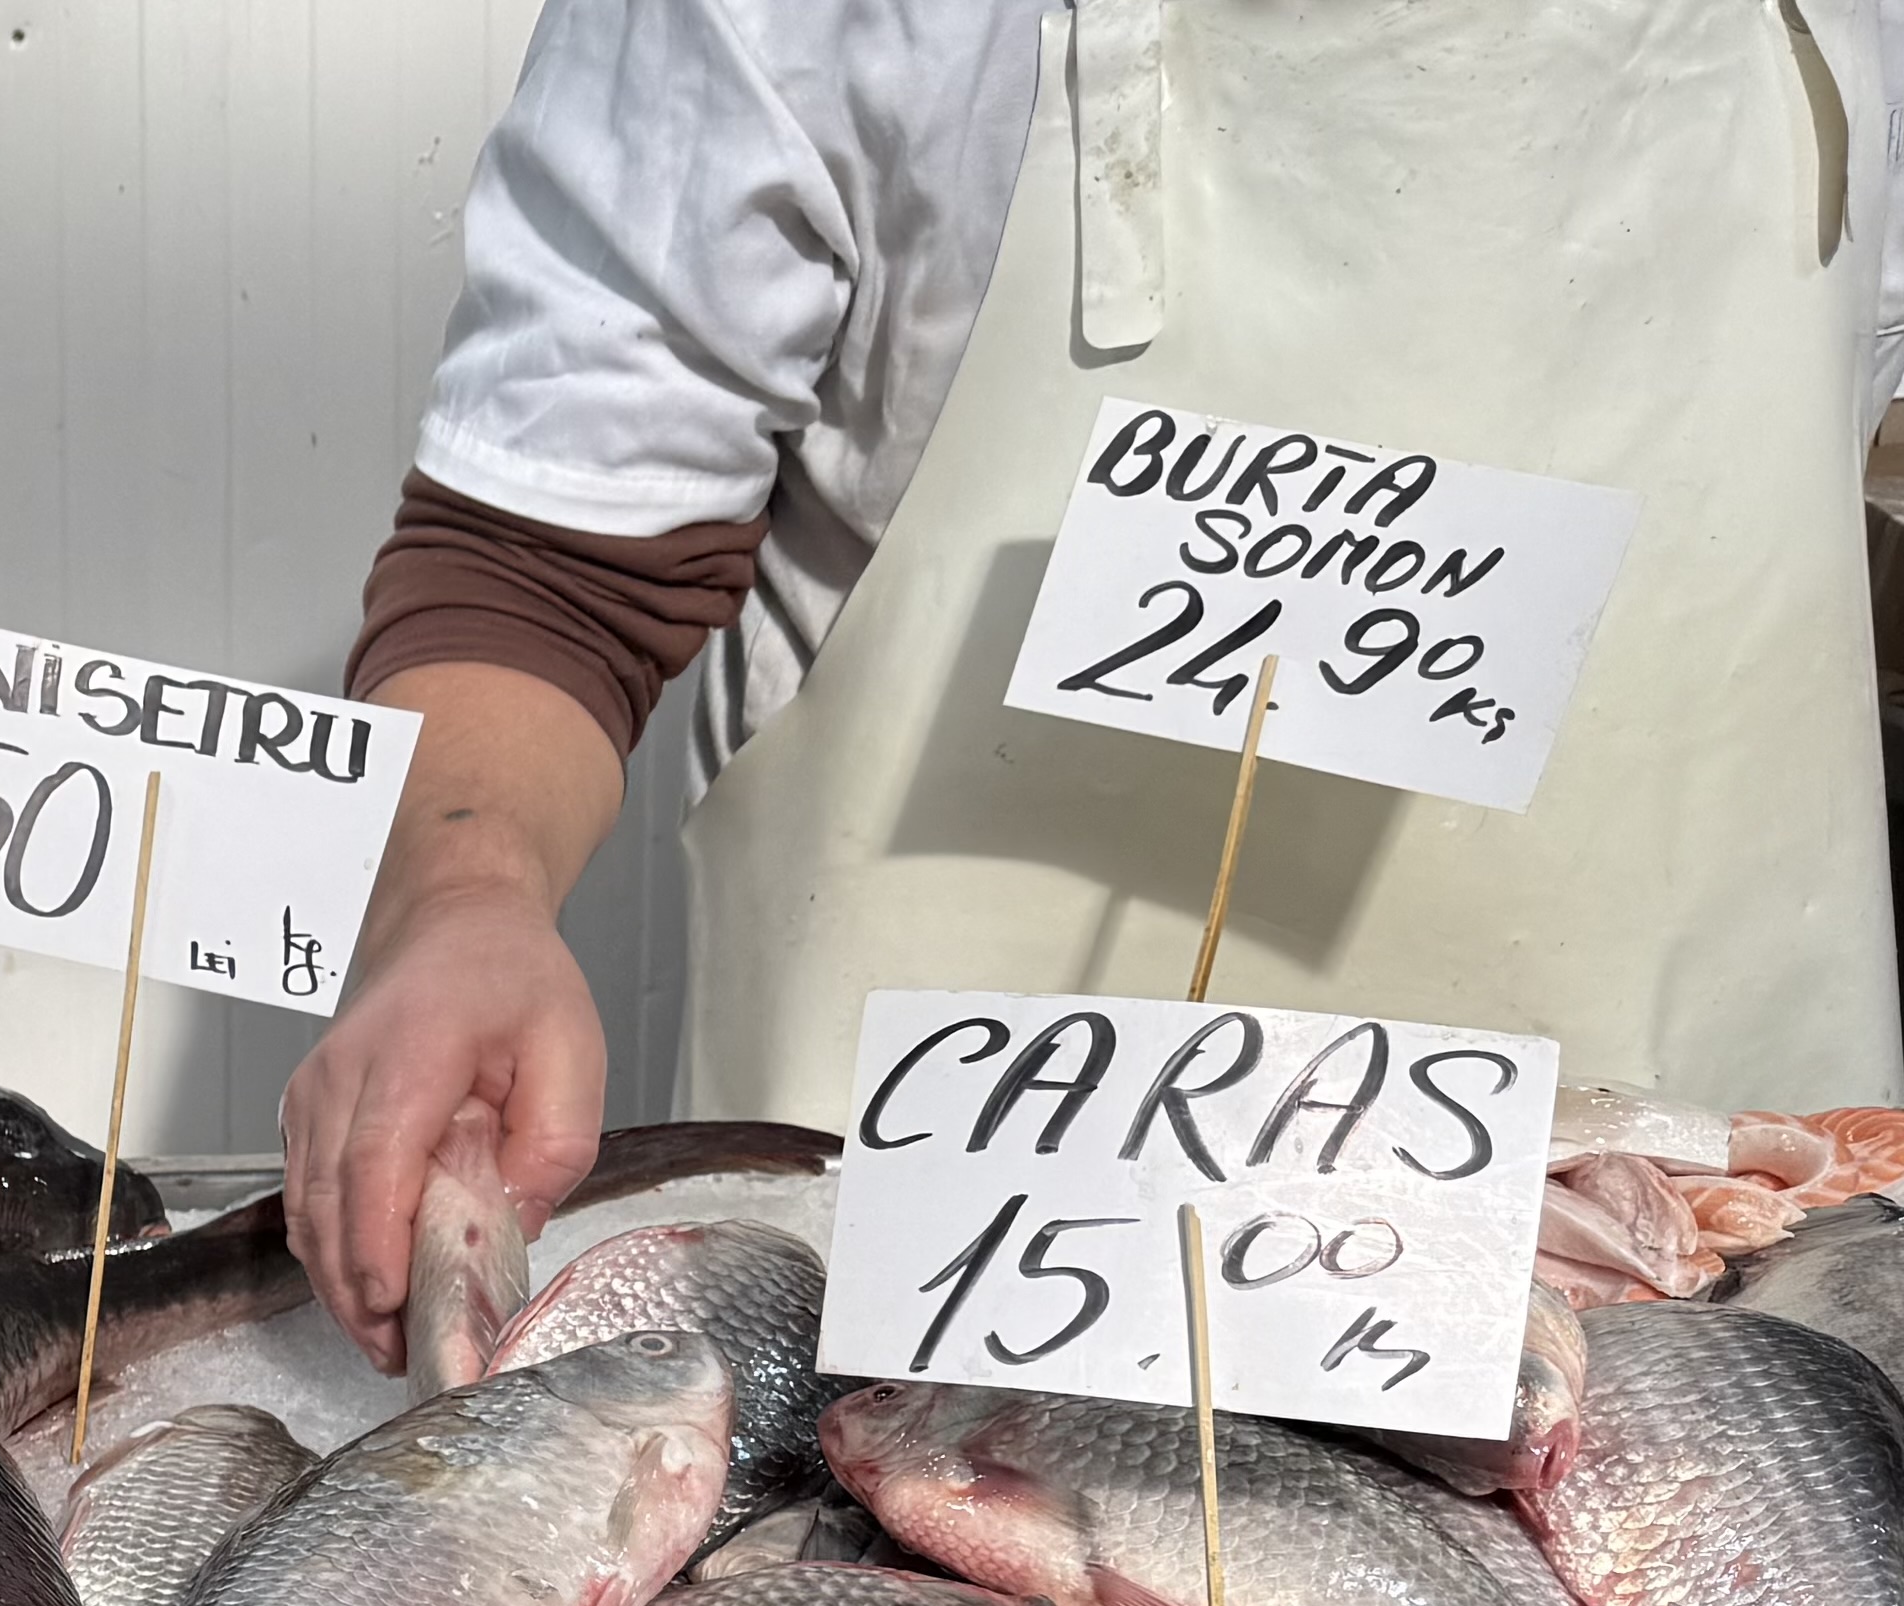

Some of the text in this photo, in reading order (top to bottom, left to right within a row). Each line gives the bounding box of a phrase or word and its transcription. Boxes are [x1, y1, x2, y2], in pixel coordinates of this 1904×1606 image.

[1087, 410, 1437, 527] BURTA
[1179, 508, 1504, 598] SOMON
[859, 1012, 1518, 1182] CARAS
